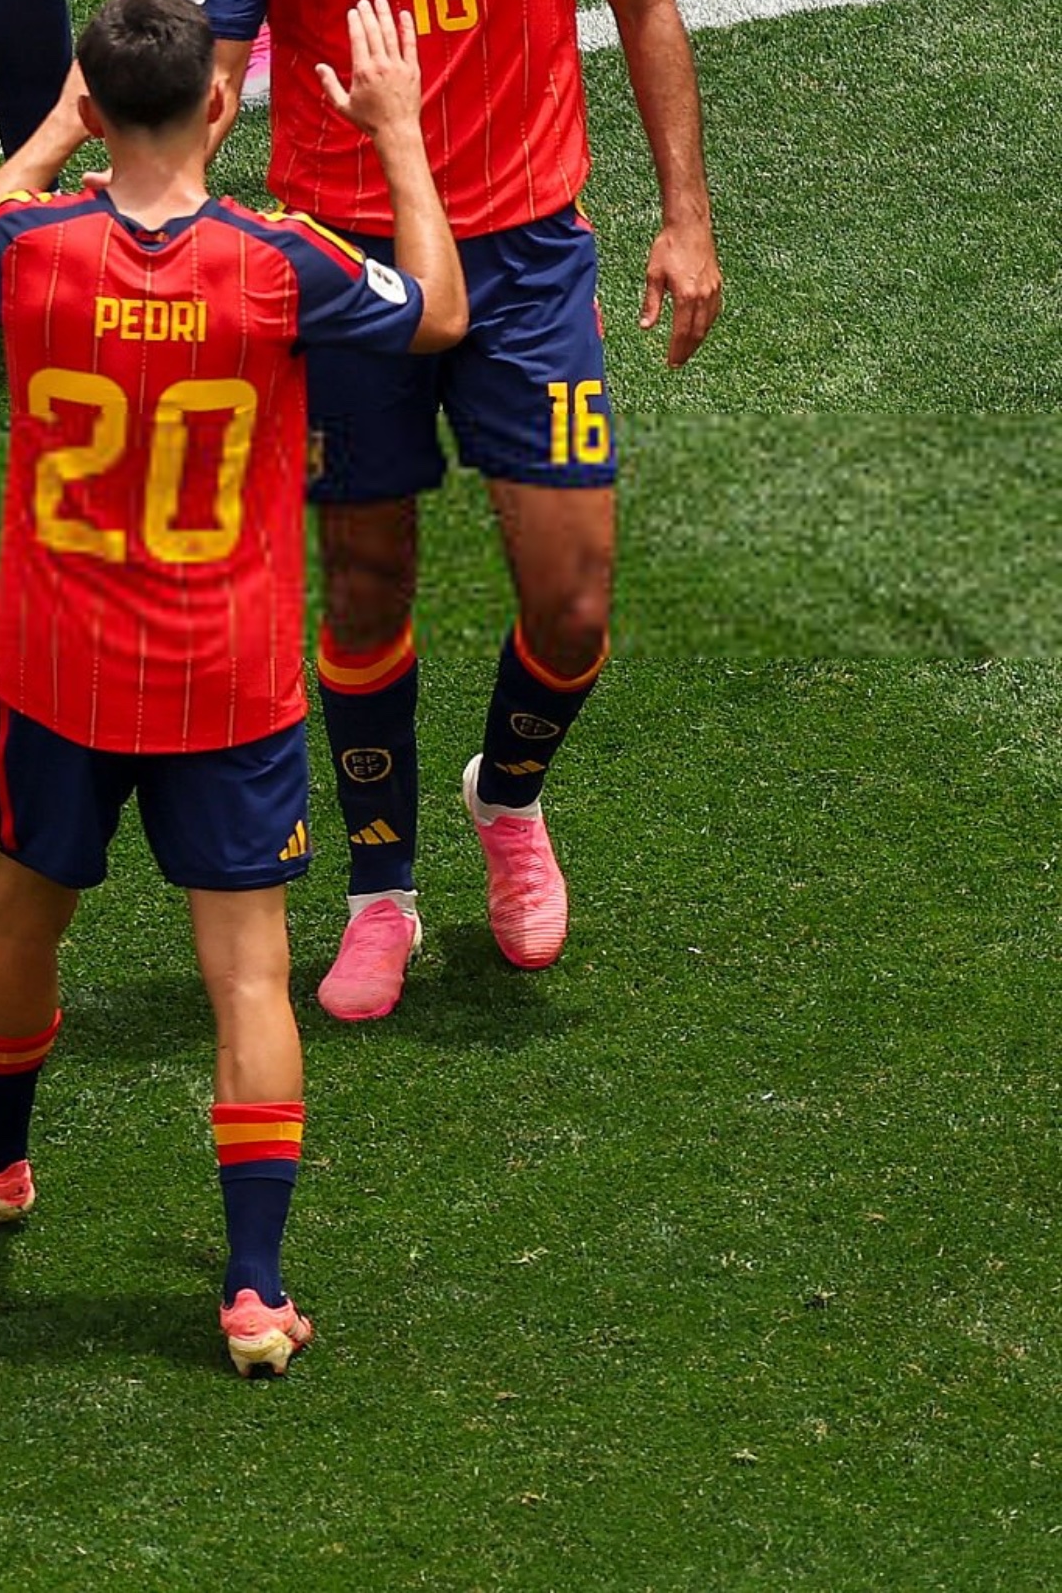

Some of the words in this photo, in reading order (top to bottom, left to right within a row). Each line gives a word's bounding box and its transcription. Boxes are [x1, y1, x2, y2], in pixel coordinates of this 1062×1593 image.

[95, 296, 207, 342] PEDRI
[548, 380, 610, 464] 16
[28, 368, 258, 564] 20
